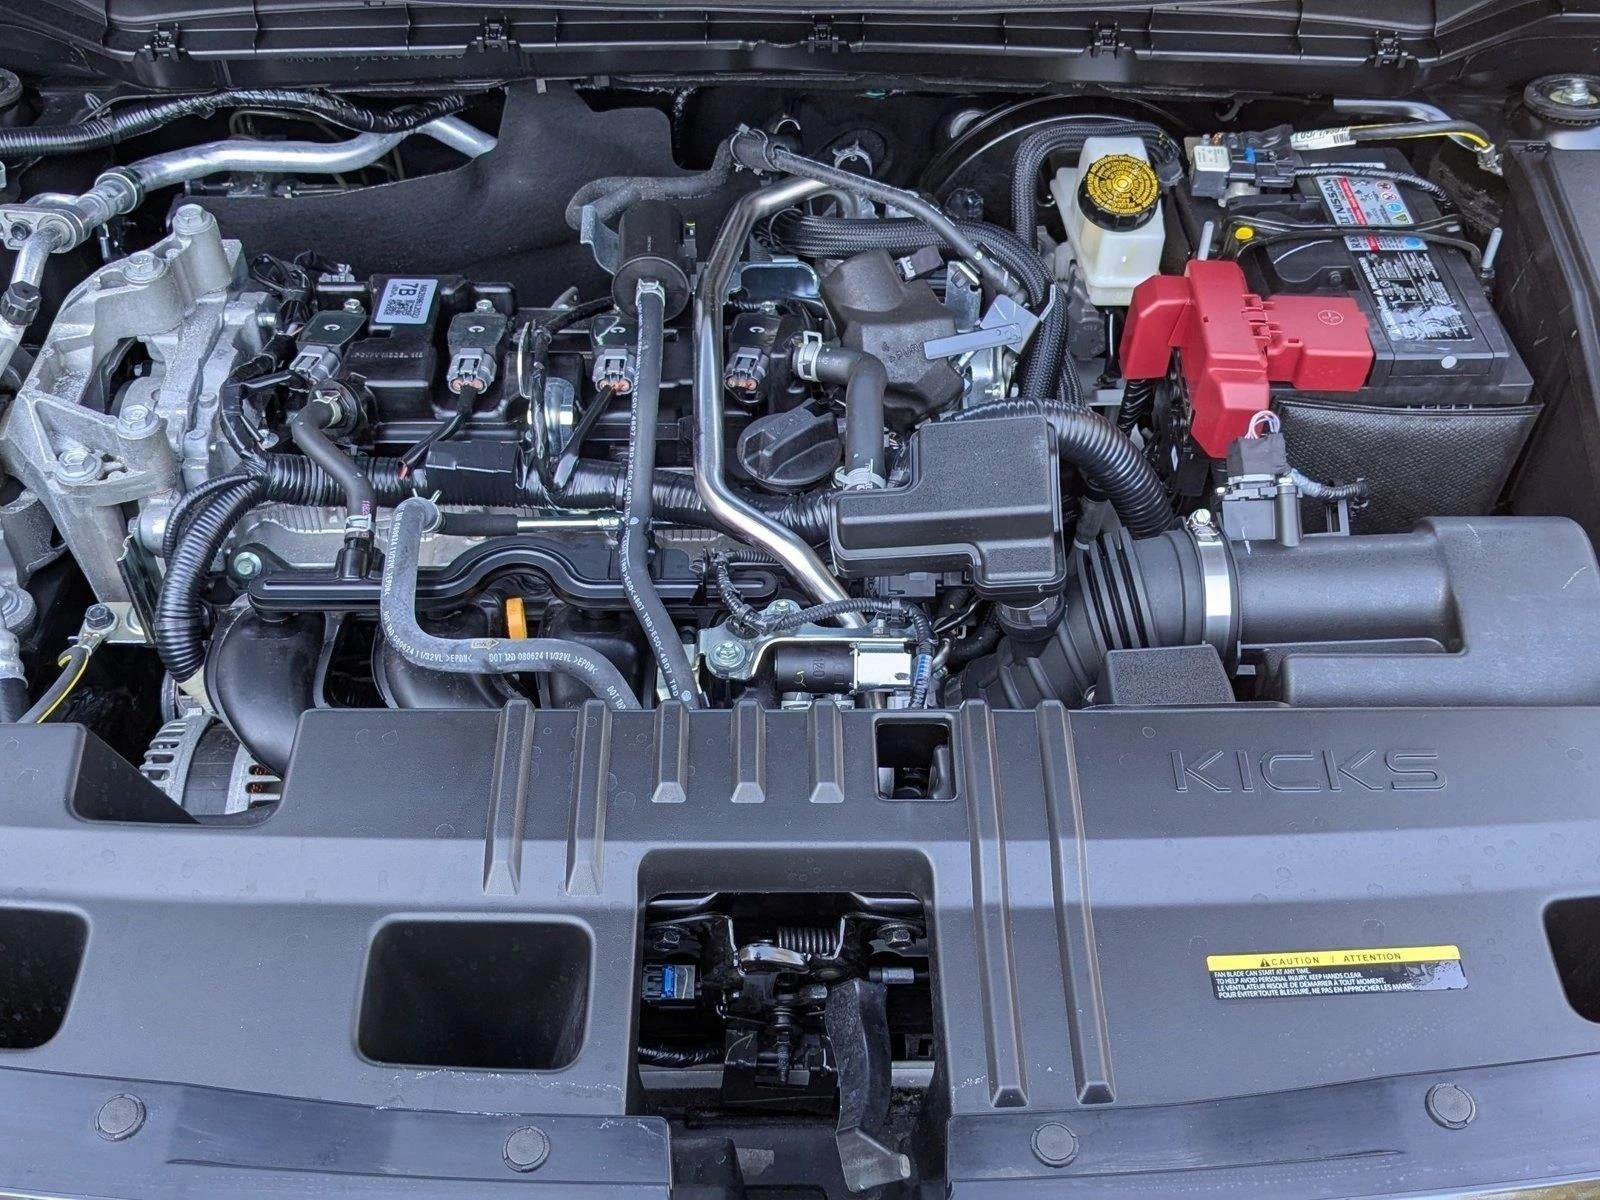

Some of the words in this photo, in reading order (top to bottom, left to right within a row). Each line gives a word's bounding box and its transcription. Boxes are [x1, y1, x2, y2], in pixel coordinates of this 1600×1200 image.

[1323, 179, 1346, 214] NISSAN
[398, 282, 420, 296] 7B
[517, 651, 544, 662] 080624
[606, 685, 621, 701] DOT
[1171, 749, 1448, 793] KICKS
[1271, 956, 1320, 967] CAUTION
[1343, 952, 1401, 963] ATTENTION
[1216, 977, 1225, 985] TO
[1240, 976, 1258, 984] AVOID
[1258, 974, 1288, 983] PERSONAL
[1322, 972, 1343, 980] HANDS
[1343, 971, 1363, 979] CLEAR.
[1226, 970, 1244, 978] BLADE
[1245, 969, 1258, 977] CAN
[1258, 968, 1275, 976] START
[1217, 984, 1226, 992] LE
[1225, 982, 1266, 991] VENTILATEUR
[1266, 981, 1290, 989] RISQUE
[1289, 981, 1299, 989] DE
[1339, 978, 1356, 986] TOUT
[1218, 991, 1237, 999] POUR
[1258, 989, 1279, 997] TOUTE
[1320, 986, 1333, 994] PAS
[1333, 986, 1343, 994] EN
[1343, 984, 1380, 992] APPROCHER
[1380, 983, 1392, 991] LES
